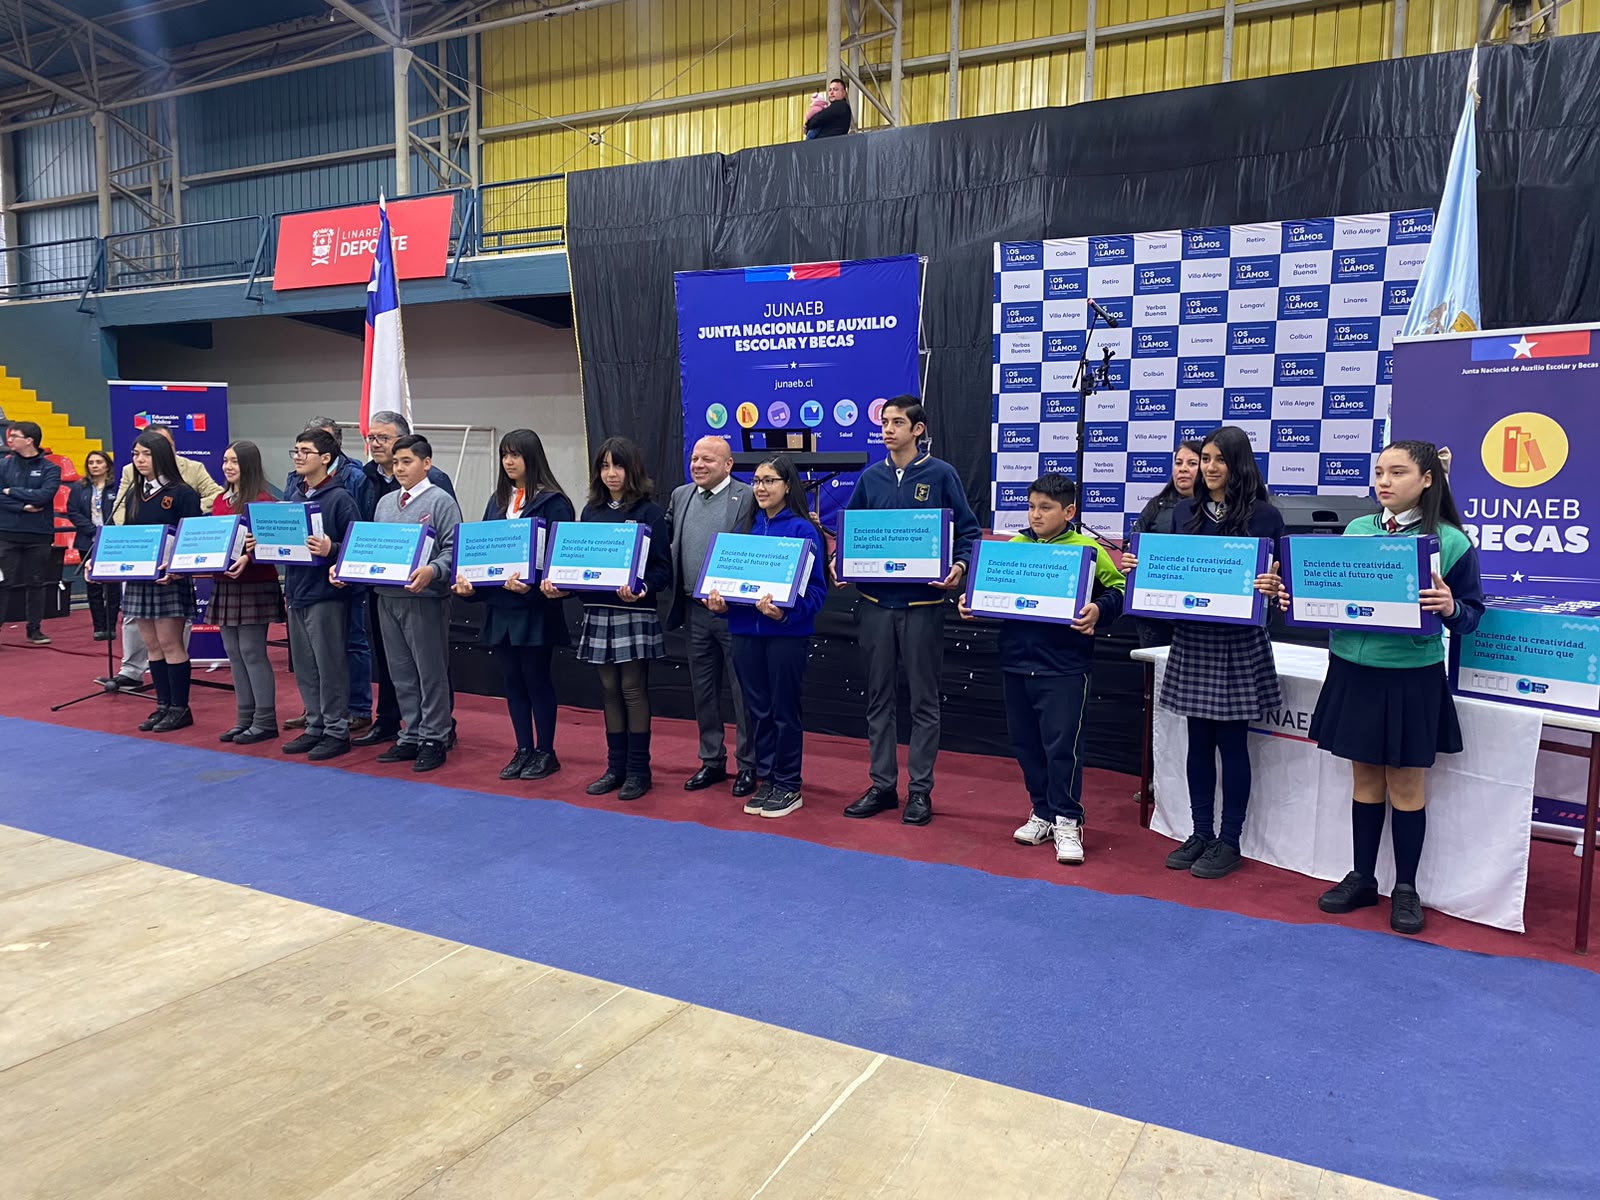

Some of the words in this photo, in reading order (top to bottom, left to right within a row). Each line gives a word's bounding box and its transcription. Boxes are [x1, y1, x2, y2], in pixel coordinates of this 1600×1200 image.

[342, 227, 378, 240] LINARE
[340, 235, 408, 256] DEPOTE
[764, 301, 823, 317] JUNAEB
[698, 325, 741, 339] JUNTA
[743, 321, 814, 336] NACIONAL
[817, 320, 834, 332] DE
[837, 316, 897, 331] AUXILIO
[736, 338, 796, 351] ESCOLAR
[798, 337, 807, 348] Y
[810, 334, 854, 348] BECAS
[775, 379, 813, 390] junaeb.cl
[1464, 499, 1580, 519] JUNAEB
[1463, 523, 1589, 553] BECAS
[1028, 562, 1068, 570] creatividad.
[1149, 554, 1184, 562] Enciende
[1196, 556, 1243, 565] creatividad.
[1352, 561, 1403, 569] creatividad.
[1147, 572, 1184, 581] imaginas.
[1304, 579, 1343, 588] imaginas.
[1475, 631, 1516, 642] Enciende
[1530, 637, 1586, 649] creatividad.
[1474, 651, 1517, 663] imaginas.
[1475, 641, 1493, 649] Dale
[1496, 643, 1511, 651] clic
[1524, 646, 1554, 656] futuro
[1556, 651, 1574, 659] que
